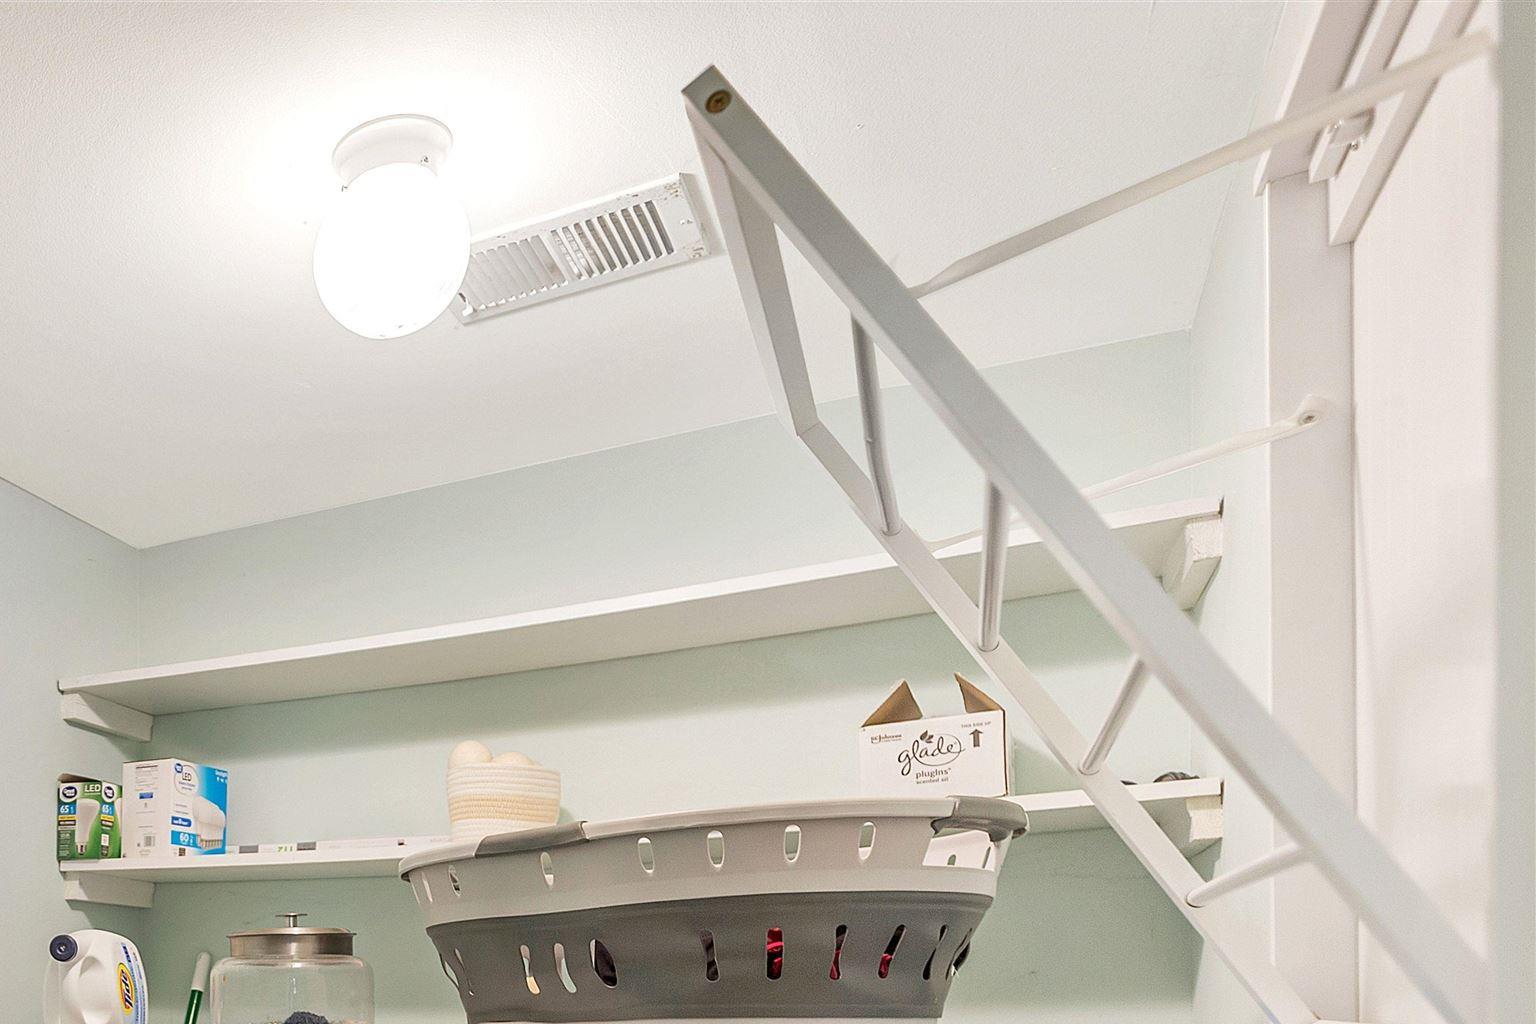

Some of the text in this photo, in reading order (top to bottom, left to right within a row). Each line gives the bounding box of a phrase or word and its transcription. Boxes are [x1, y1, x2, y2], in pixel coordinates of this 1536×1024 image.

[897, 736, 959, 776] glade
[84, 783, 101, 793] LED
[59, 804, 70, 813] 65
[179, 832, 190, 842] 60
[121, 968, 134, 1009] Tide
